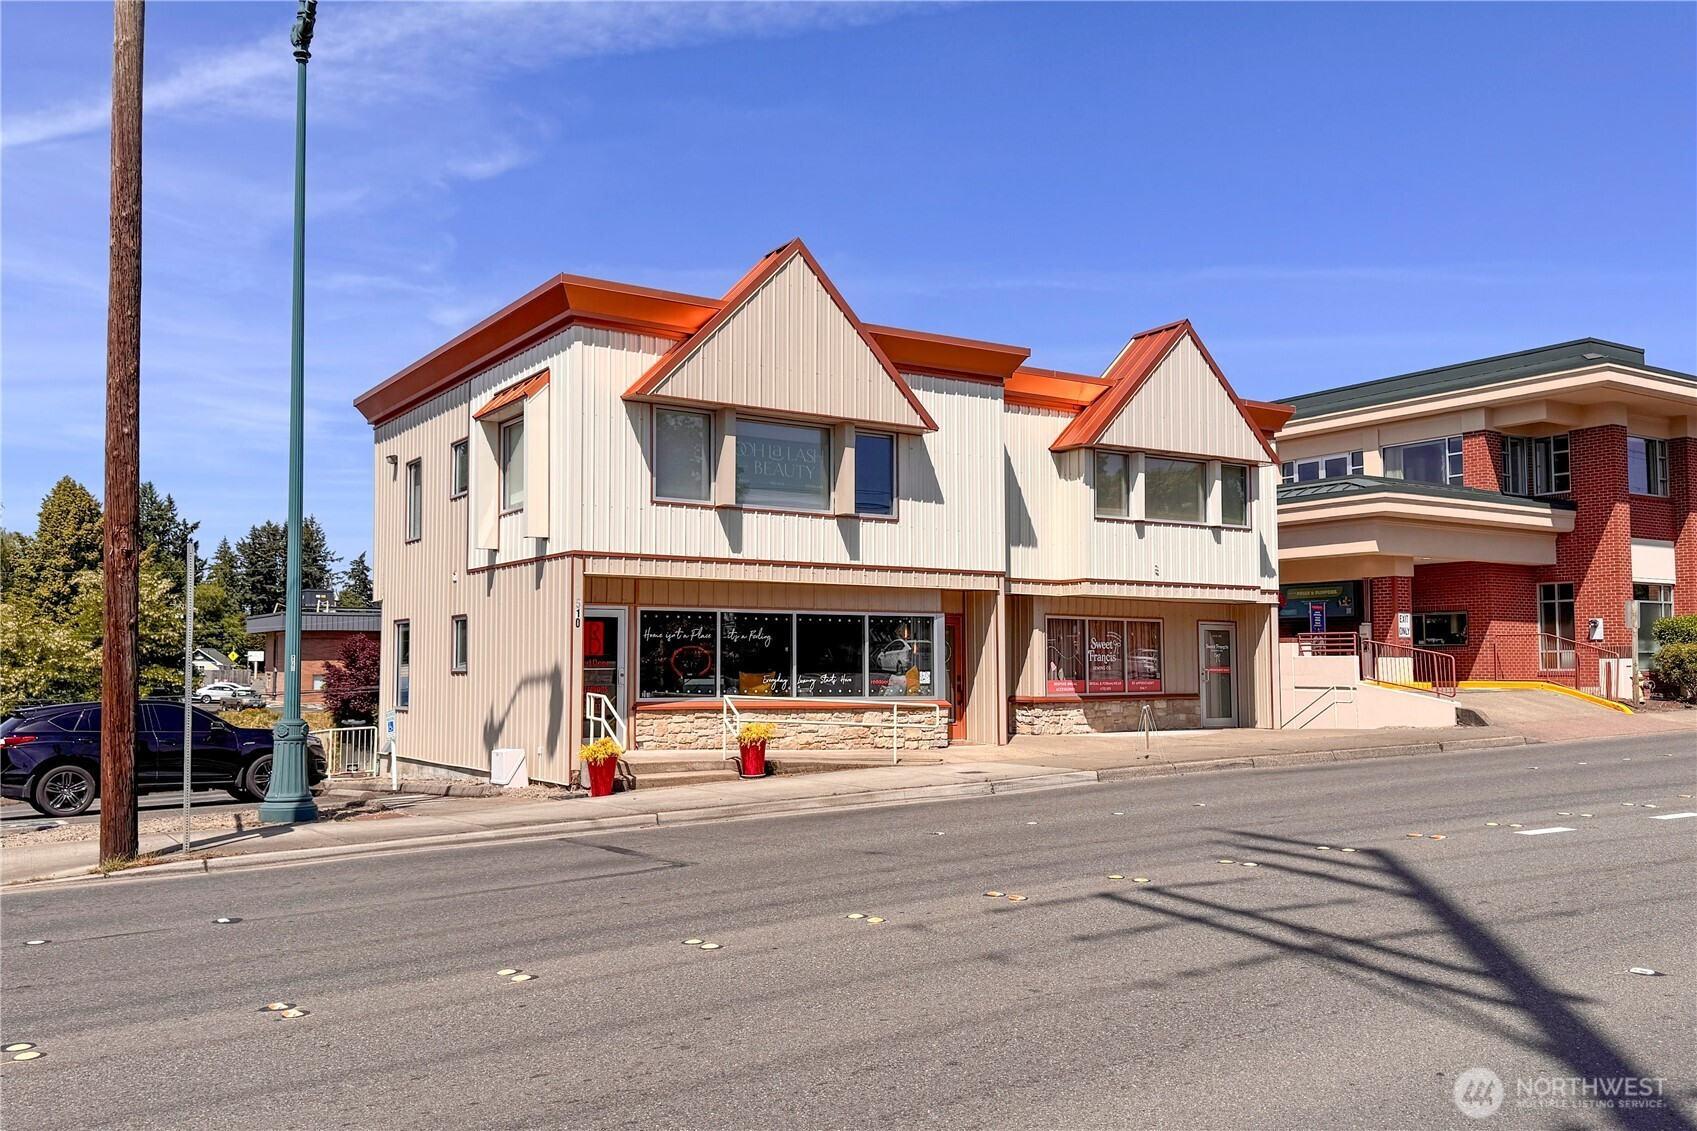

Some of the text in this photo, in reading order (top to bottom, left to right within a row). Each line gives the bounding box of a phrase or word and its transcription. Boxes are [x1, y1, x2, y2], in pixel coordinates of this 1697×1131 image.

[787, 446, 824, 465] LASH
[754, 460, 816, 479] BEAUTY
[1399, 614, 1409, 623] EXIT
[643, 627, 663, 641] Home
[690, 626, 711, 641] Place
[1399, 626, 1410, 636] ONLY
[1091, 637, 1113, 649] Sweet
[1088, 650, 1117, 664] Francis
